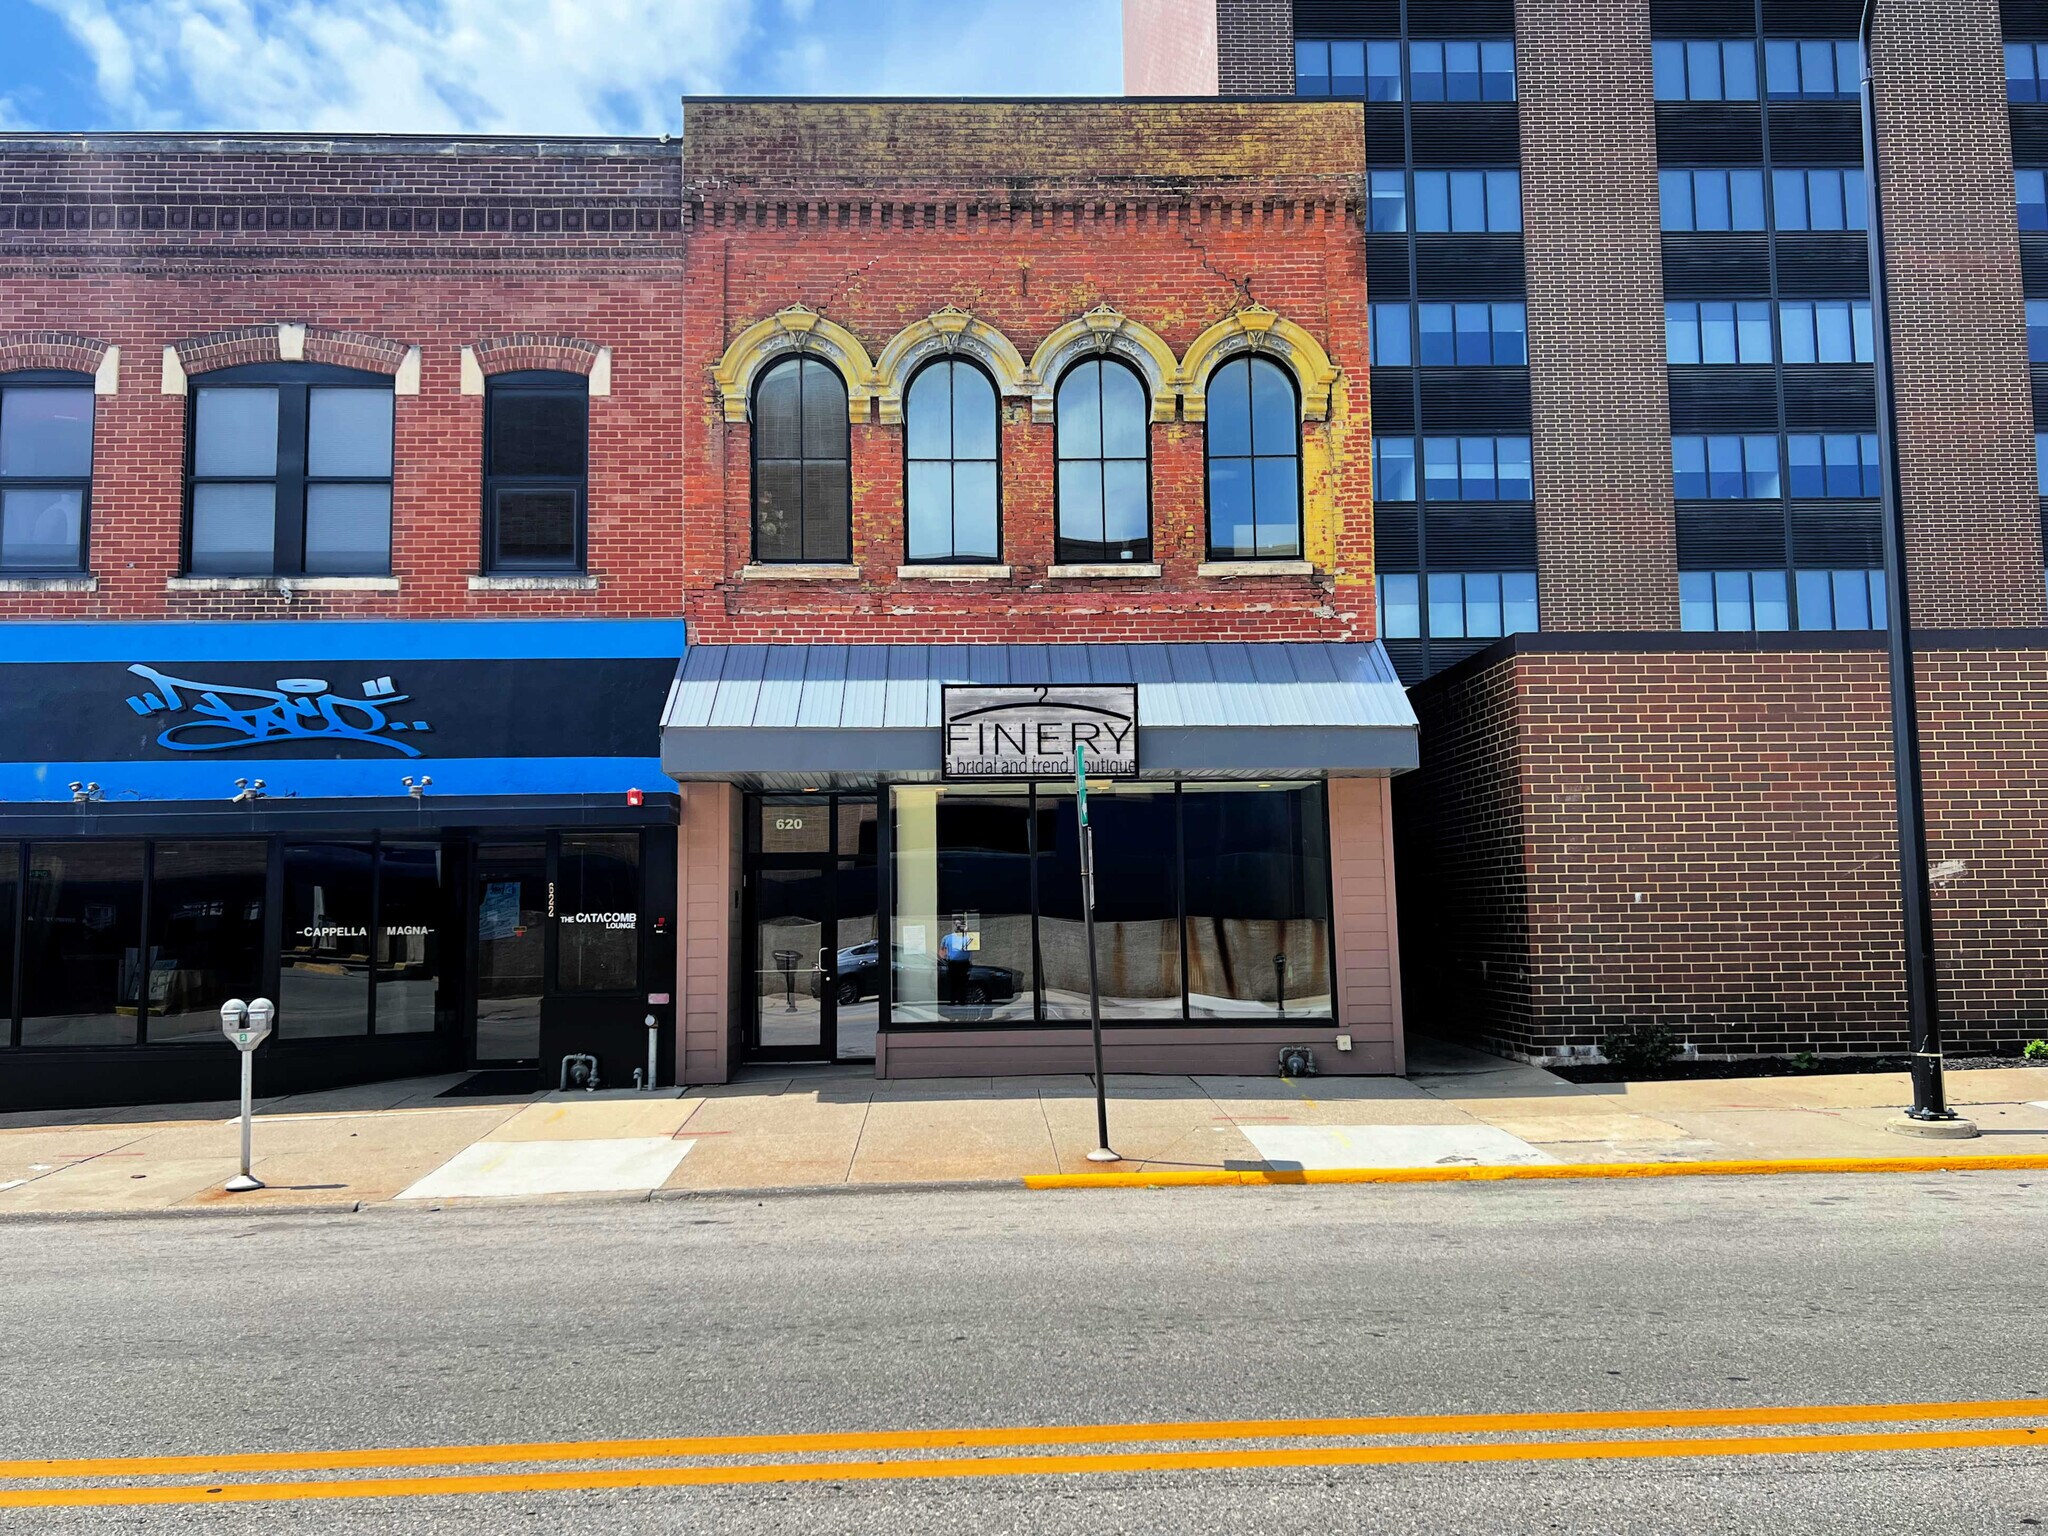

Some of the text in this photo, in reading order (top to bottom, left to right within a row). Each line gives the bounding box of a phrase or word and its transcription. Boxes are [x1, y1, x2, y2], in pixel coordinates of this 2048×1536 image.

[947, 722, 1133, 755] FINERY
[945, 756, 1136, 775] a bridal and trend outique
[776, 818, 803, 830] 620
[560, 912, 637, 923] THE CATACOMB
